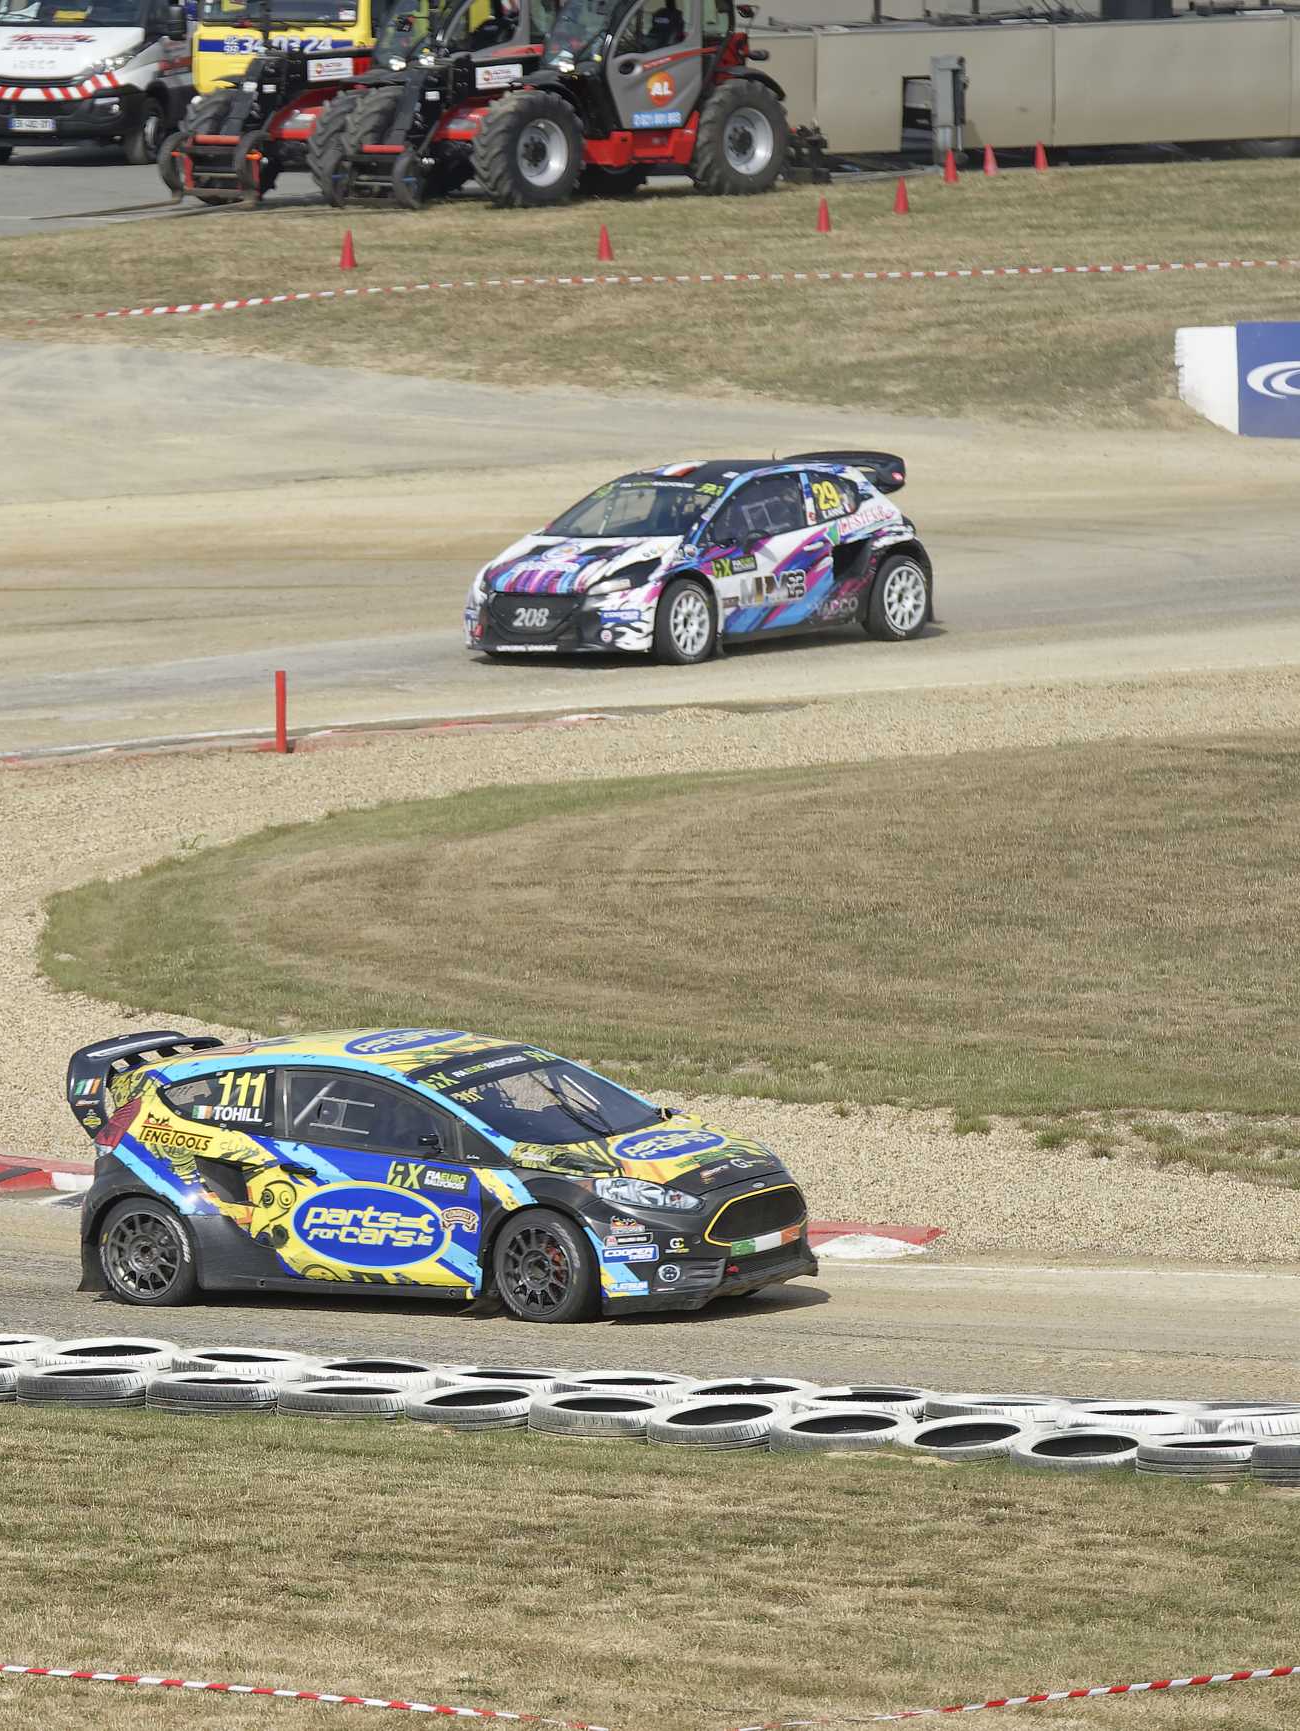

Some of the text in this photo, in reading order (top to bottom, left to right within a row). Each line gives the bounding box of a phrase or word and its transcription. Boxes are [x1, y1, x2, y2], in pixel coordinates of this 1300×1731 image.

[303, 36, 333, 54] 24
[811, 481, 840, 510] 29
[512, 607, 550, 627] 208
[217, 1071, 267, 1107] 111
[213, 1105, 264, 1123] TOHILL
[302, 1205, 399, 1231] parts
